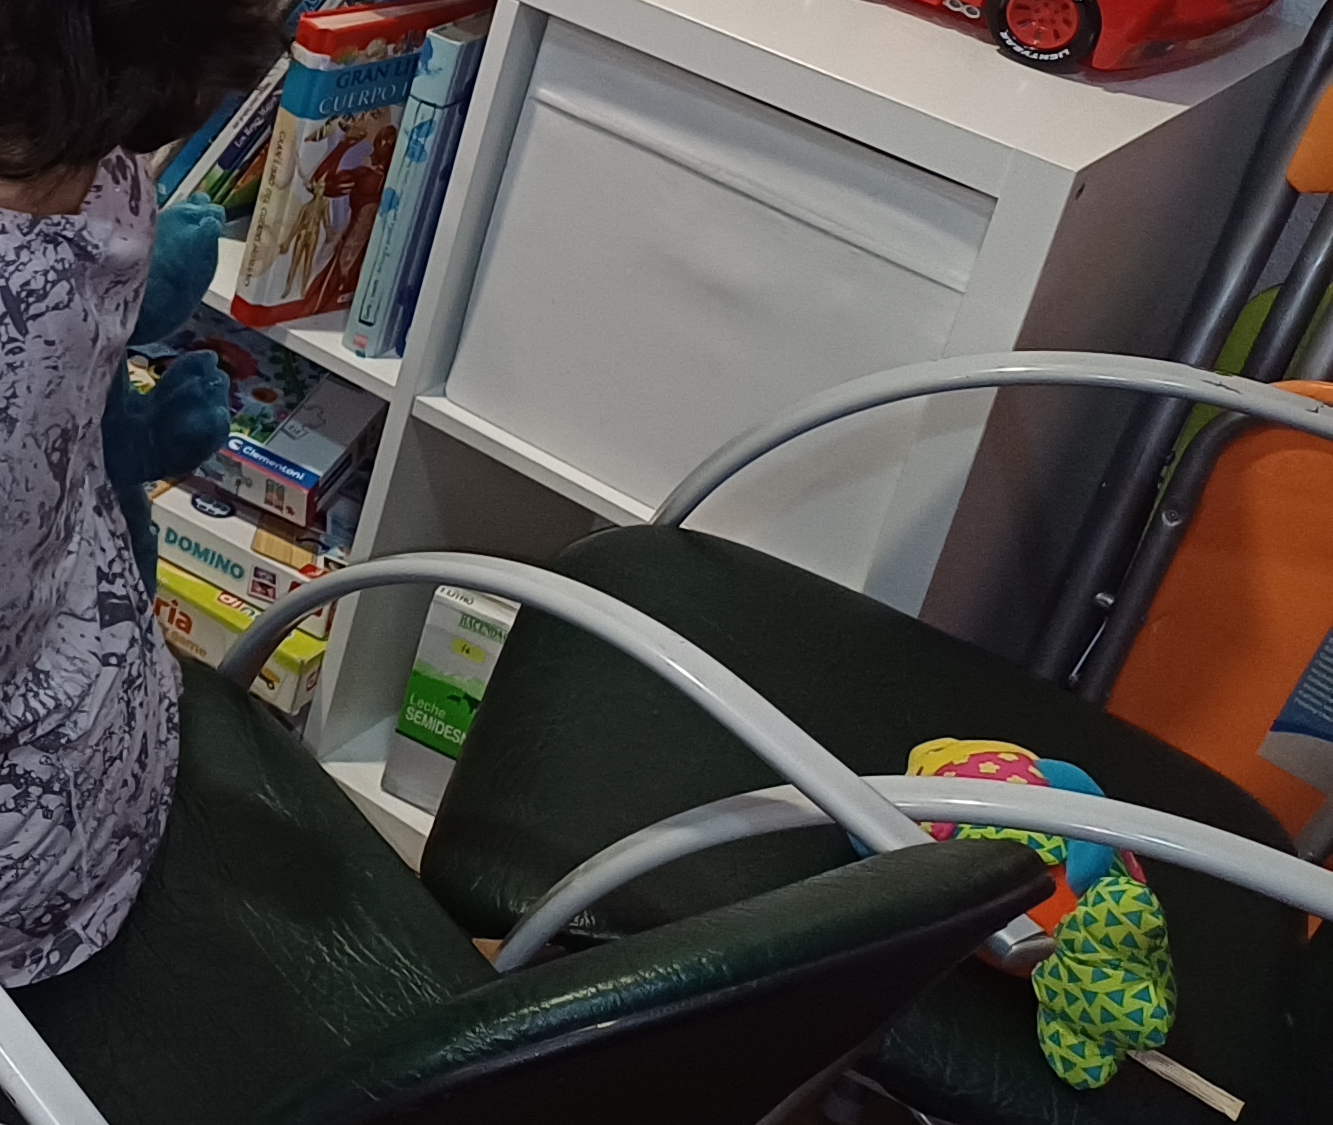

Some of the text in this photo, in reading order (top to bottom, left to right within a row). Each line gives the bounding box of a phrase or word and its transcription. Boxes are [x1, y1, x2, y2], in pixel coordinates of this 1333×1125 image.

[335, 60, 392, 89] GRAN
[319, 86, 397, 116] CUERPO
[242, 444, 306, 481] Clementoni
[163, 527, 246, 580] DOMINO
[153, 597, 193, 636] ria
[409, 693, 447, 720] Leche
